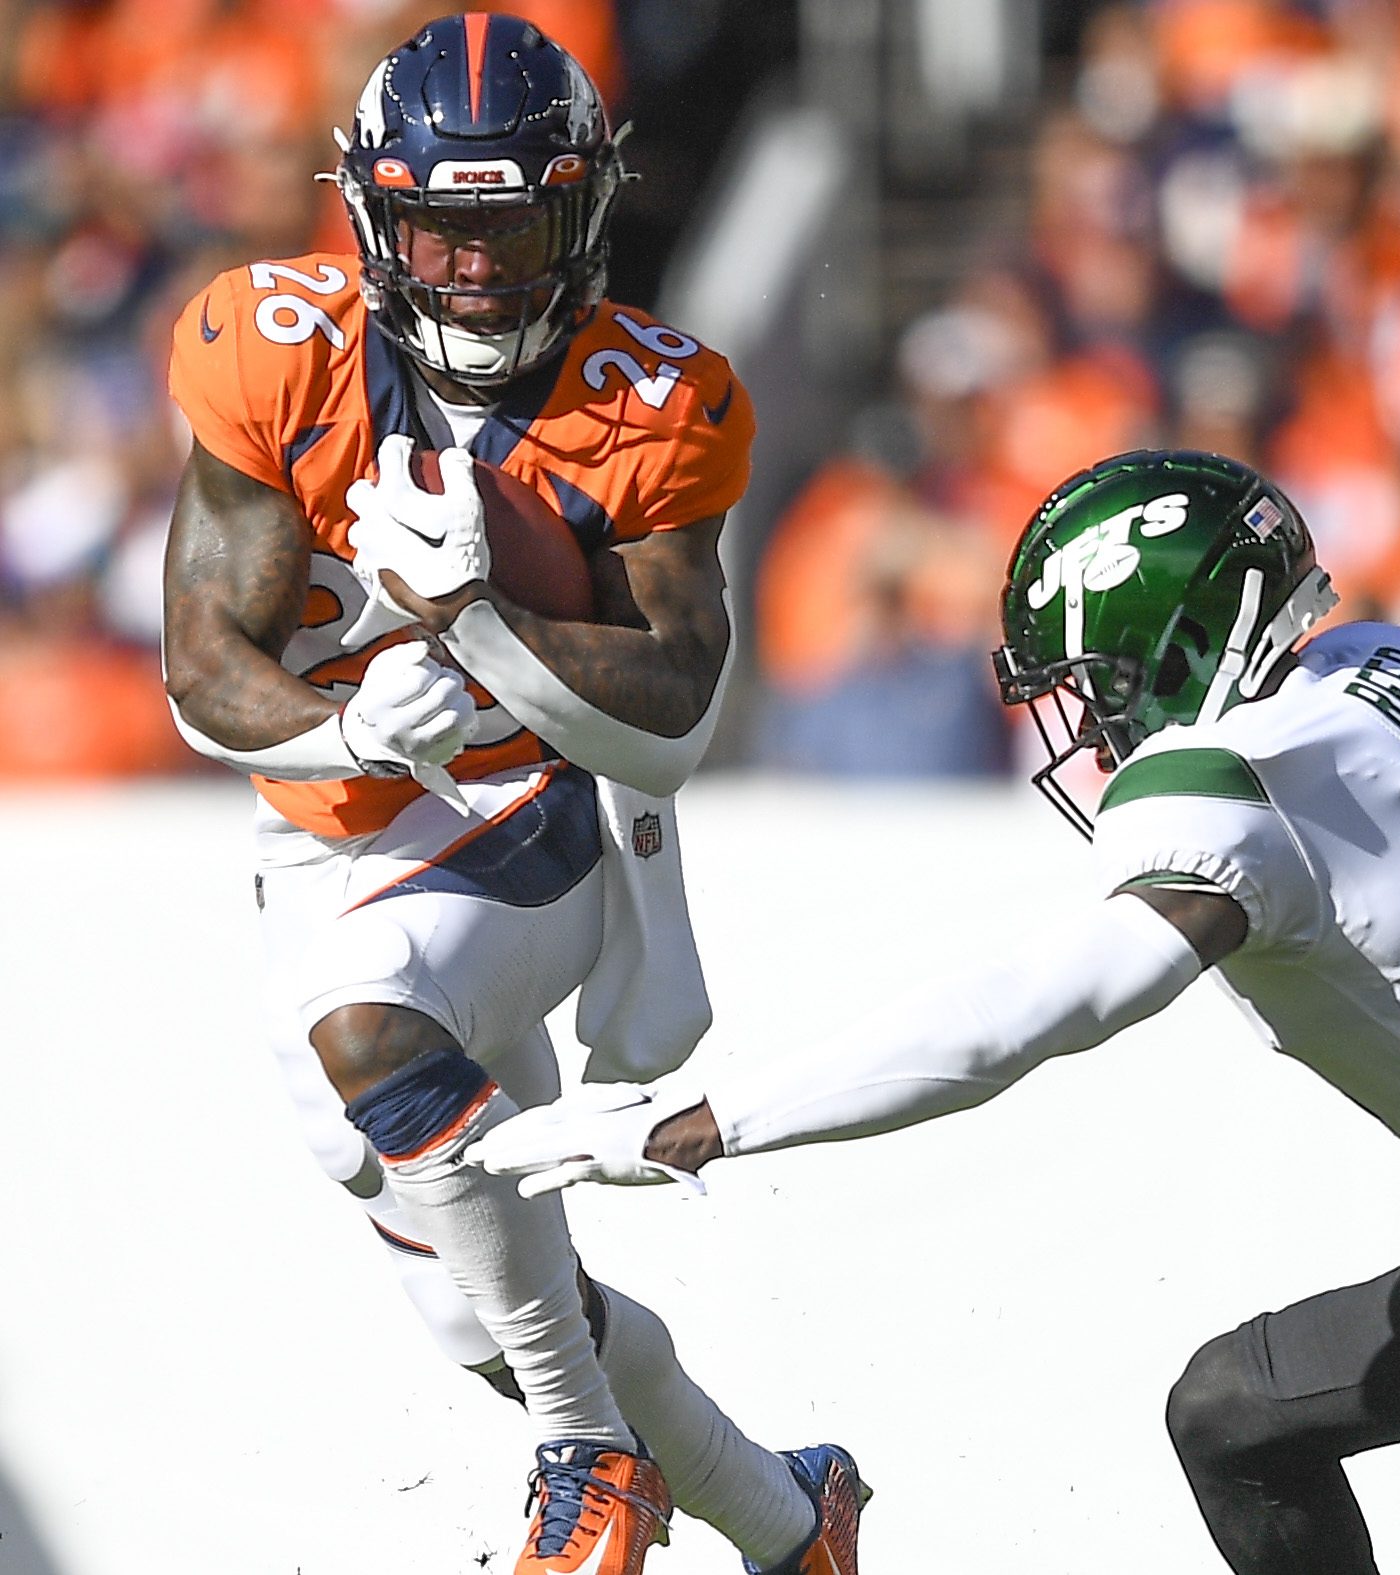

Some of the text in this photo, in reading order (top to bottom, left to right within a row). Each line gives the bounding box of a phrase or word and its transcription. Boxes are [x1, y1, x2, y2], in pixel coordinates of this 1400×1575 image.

[249, 262, 347, 351] 26
[581, 312, 699, 410] 26
[1027, 493, 1189, 610] JETS
[635, 831, 661, 853] NFL
